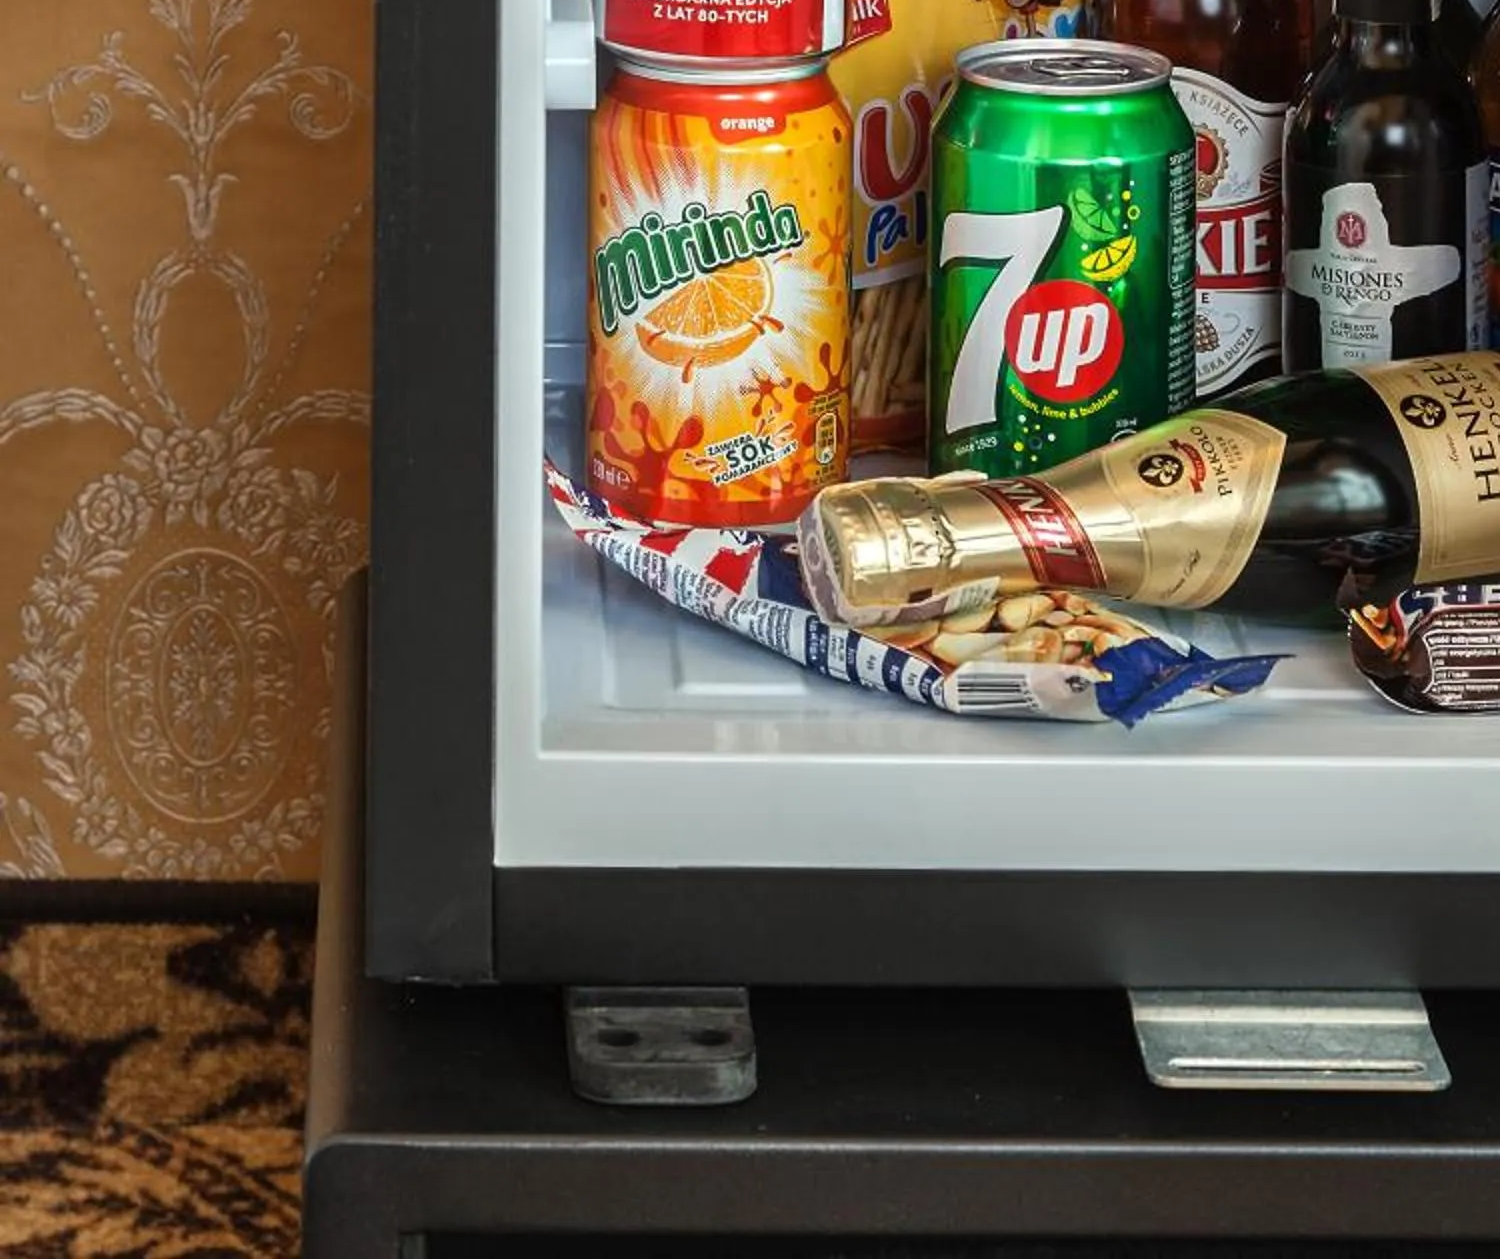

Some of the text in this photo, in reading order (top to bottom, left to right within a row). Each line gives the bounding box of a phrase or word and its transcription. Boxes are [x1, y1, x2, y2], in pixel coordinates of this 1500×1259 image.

[653, 4, 769, 24] Z LAT 80-TYCH
[720, 115, 776, 132] orange
[1196, 210, 1273, 277] KIE
[1311, 262, 1404, 289] MISIONES
[1042, 405, 1067, 420] lime
[1069, 407, 1079, 420] &
[1080, 388, 1119, 417] bubbles
[725, 436, 776, 469] SOK
